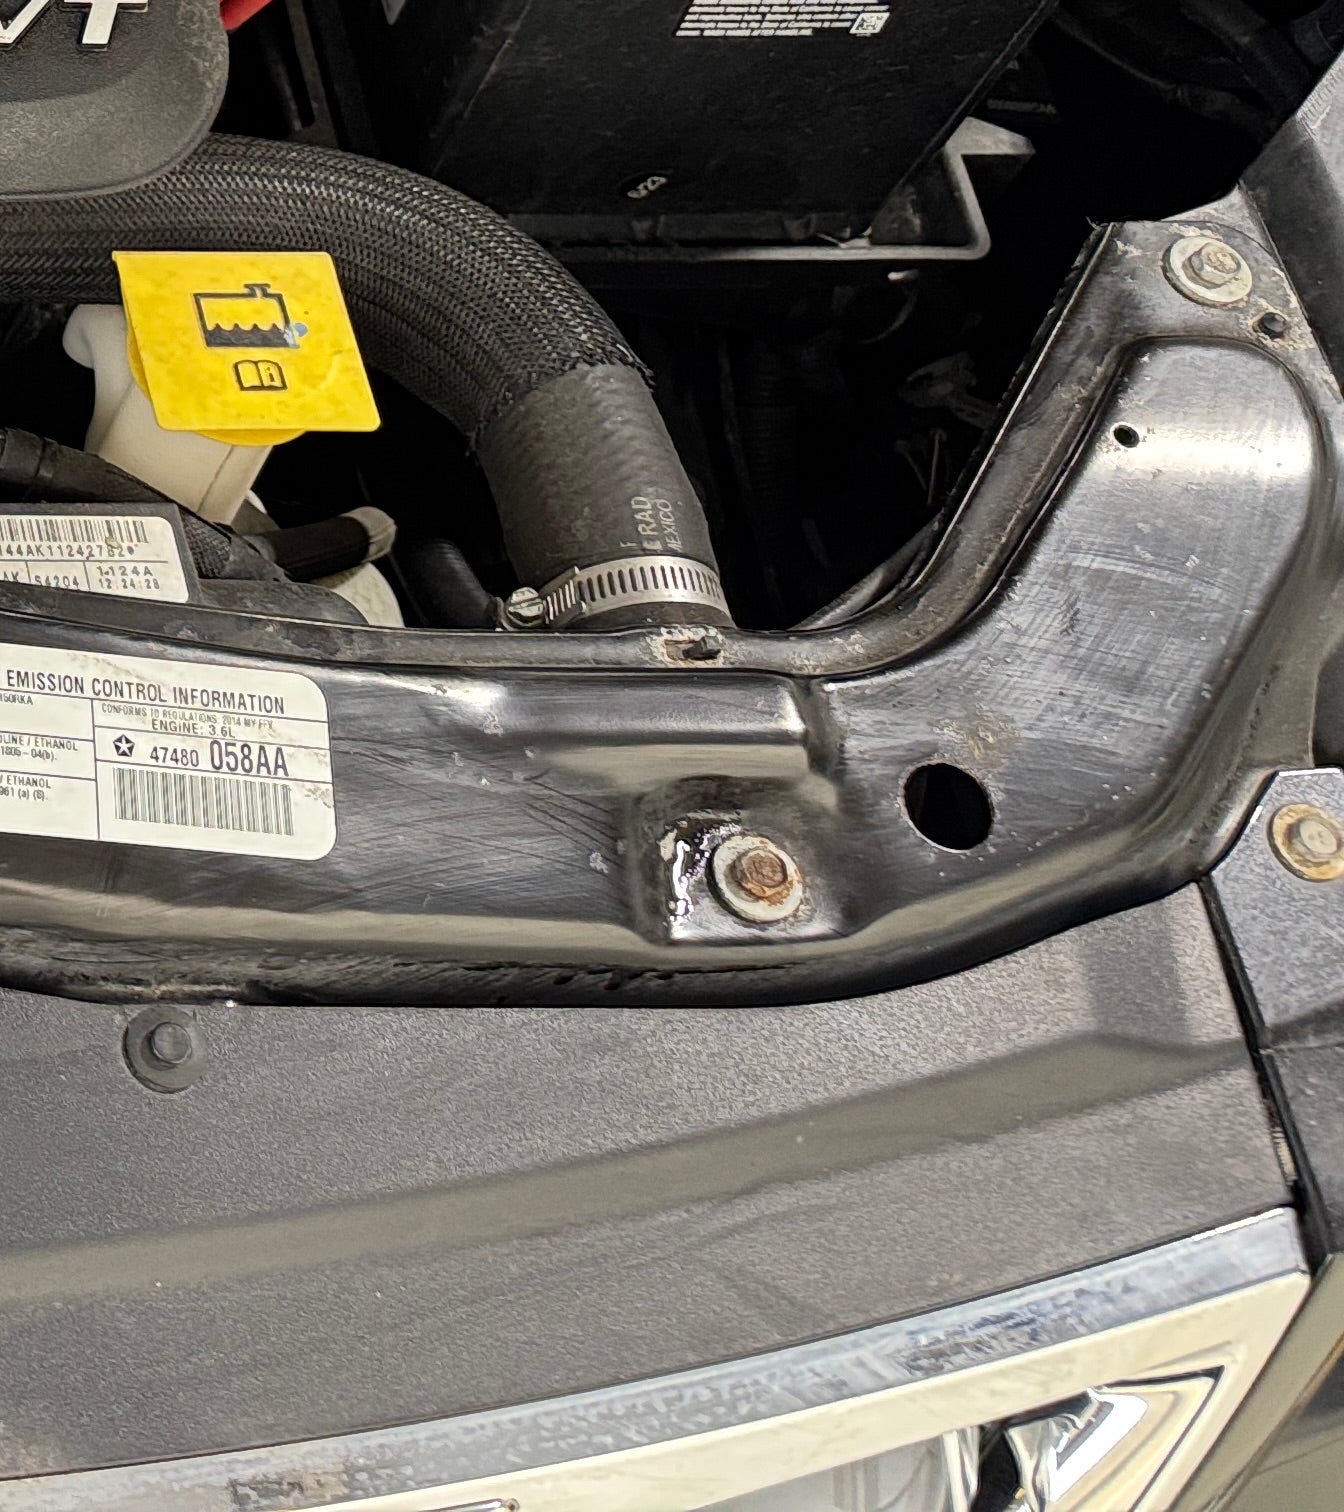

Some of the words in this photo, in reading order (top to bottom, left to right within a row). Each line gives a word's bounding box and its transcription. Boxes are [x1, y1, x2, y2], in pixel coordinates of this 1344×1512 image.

[7, 668, 84, 694] EMISSION
[91, 677, 167, 703] CONTROL
[172, 686, 285, 715] INFORMATION
[101, 703, 147, 717] CONFORMS
[149, 708, 159, 718] TO
[221, 715, 241, 726] 2014
[151, 719, 204, 735] ENGINE:
[208, 725, 235, 738] 3.6L
[34, 737, 78, 752] ETHANOL
[149, 745, 200, 767] 47480
[208, 740, 289, 777] 058AA
[6, 775, 51, 789] ETHANOL
[17, 787, 30, 800] (a)
